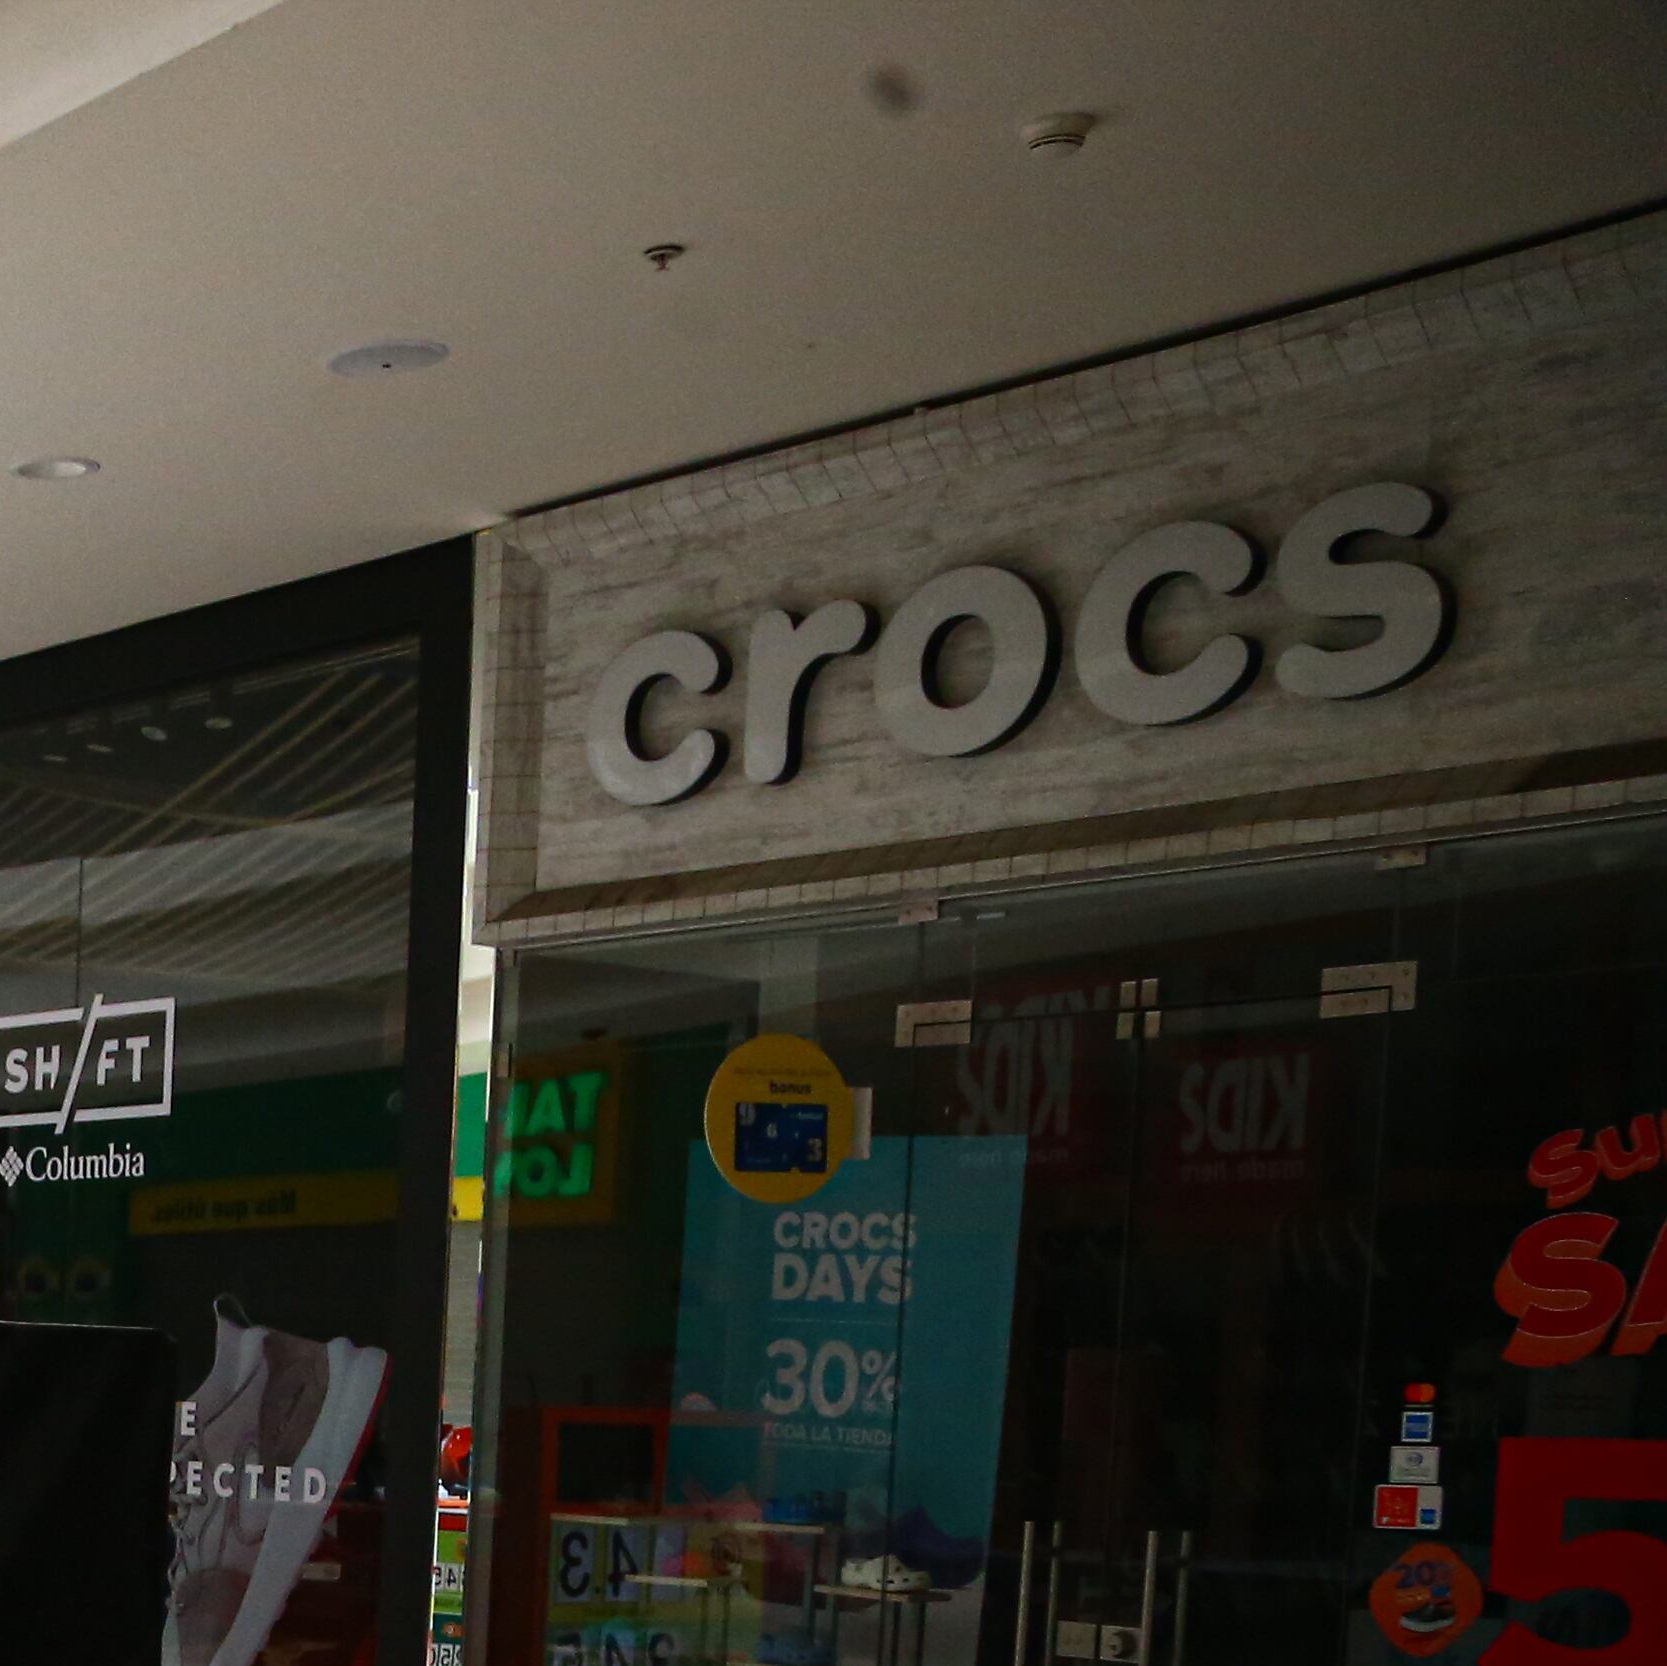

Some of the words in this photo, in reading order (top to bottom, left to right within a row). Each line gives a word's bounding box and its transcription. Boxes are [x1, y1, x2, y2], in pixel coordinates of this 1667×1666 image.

[586, 481, 1452, 806] crocs
[770, 1080, 812, 1095] bonus
[25, 1142, 145, 1183] Columbia
[1528, 1112, 1667, 1209] Su
[773, 1210, 917, 1250] CROCS
[770, 1253, 914, 1304] DAYS
